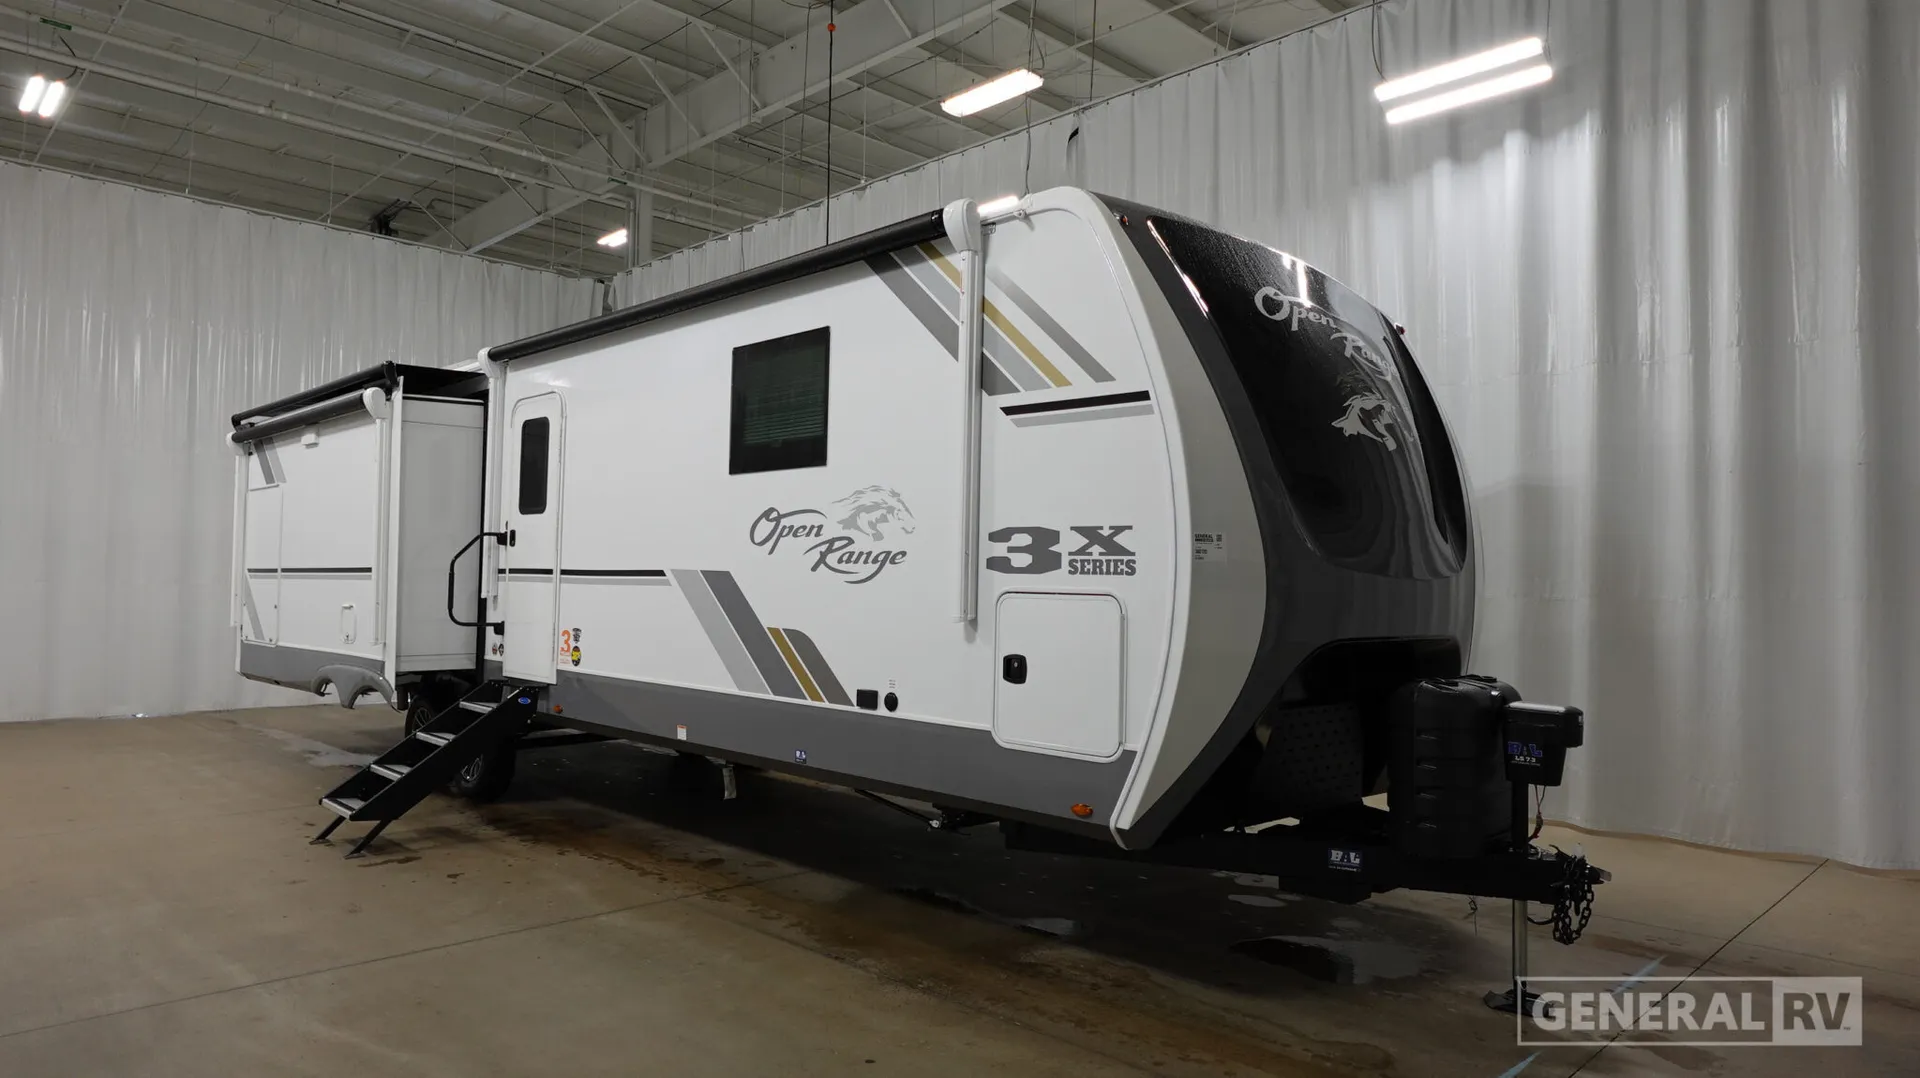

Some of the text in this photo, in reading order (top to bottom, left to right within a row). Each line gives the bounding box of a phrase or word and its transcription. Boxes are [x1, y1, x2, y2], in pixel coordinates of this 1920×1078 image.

[1254, 286, 1337, 331] Open
[750, 507, 827, 555] Open
[986, 525, 1136, 574] 3 X
[803, 536, 907, 584] Range
[1068, 558, 1137, 576] SERIES
